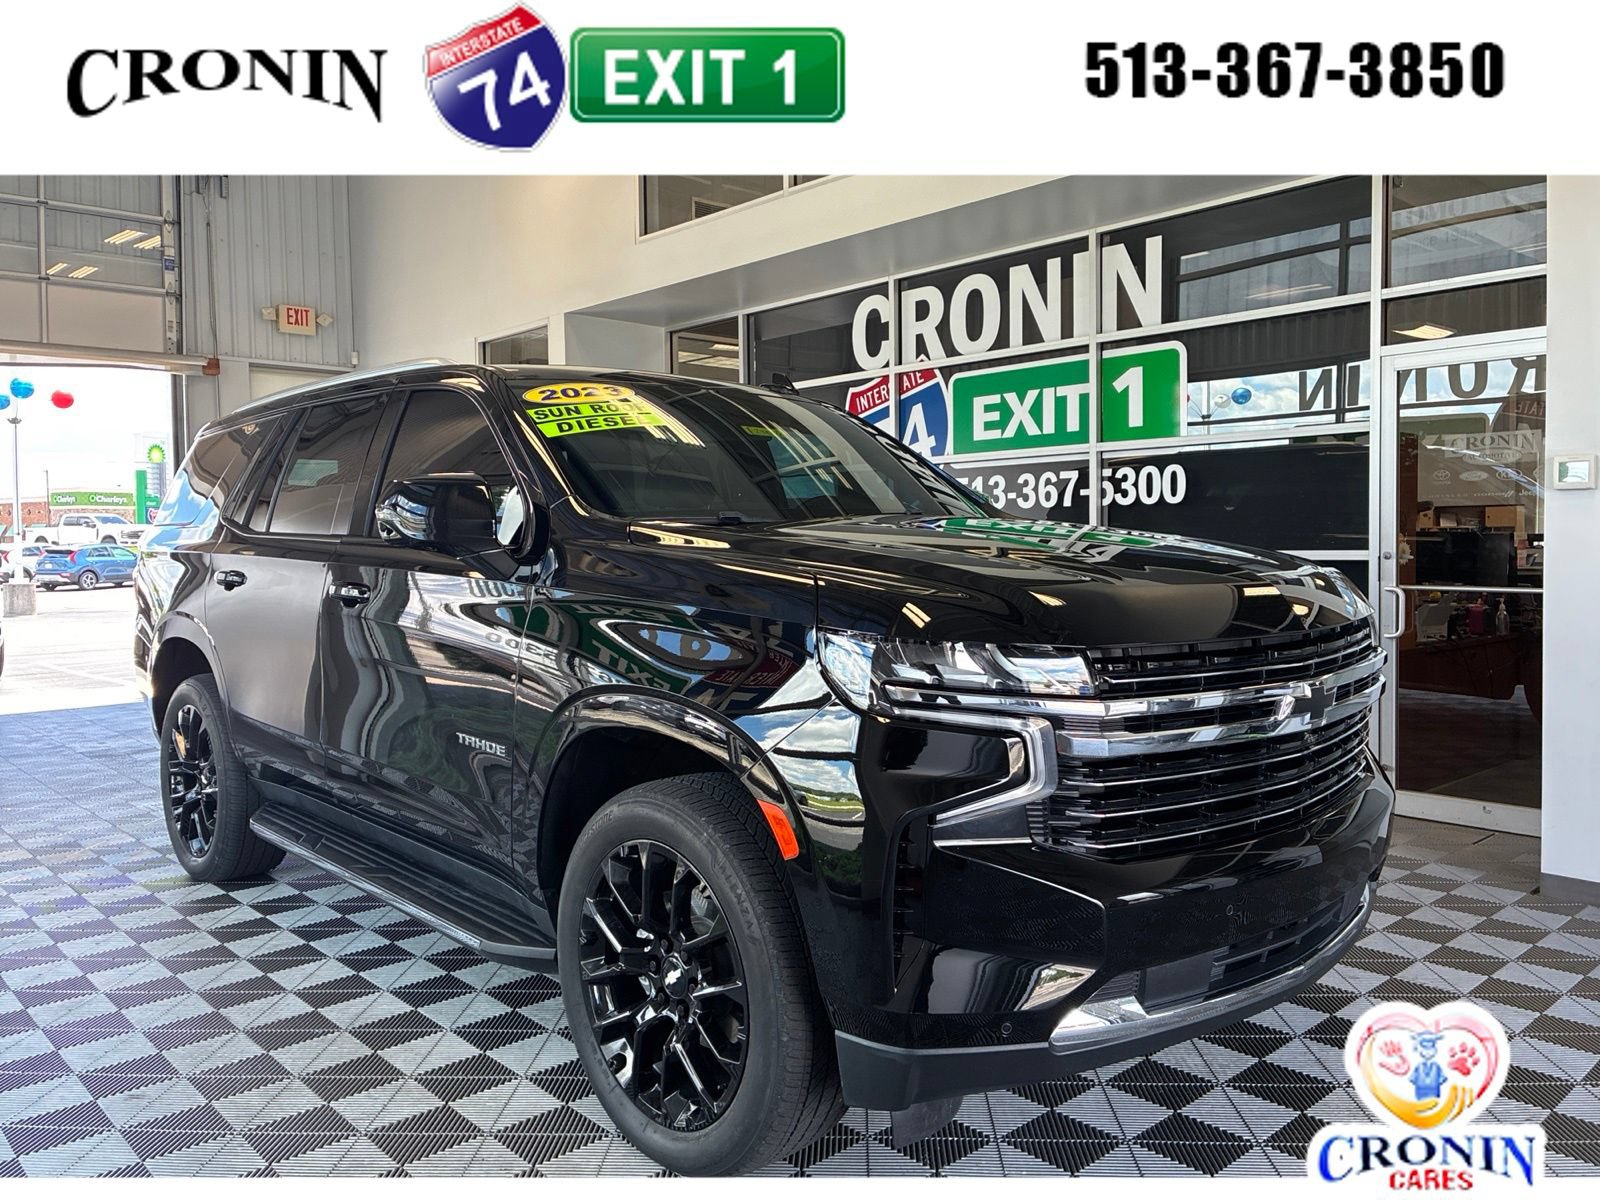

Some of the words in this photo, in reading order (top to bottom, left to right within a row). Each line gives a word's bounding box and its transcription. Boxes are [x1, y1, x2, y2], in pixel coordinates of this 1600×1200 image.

[852, 235, 1163, 370] CRONIN
[286, 307, 310, 327] EXIT
[538, 386, 624, 401] 2023
[856, 371, 925, 413] INTERATE
[534, 404, 582, 421] SUN
[973, 382, 1090, 441] EXIT
[1112, 366, 1144, 428] 1
[557, 415, 652, 434] DIESEL
[1449, 433, 1537, 454] CRONIN
[455, 731, 506, 757] TAHOE
